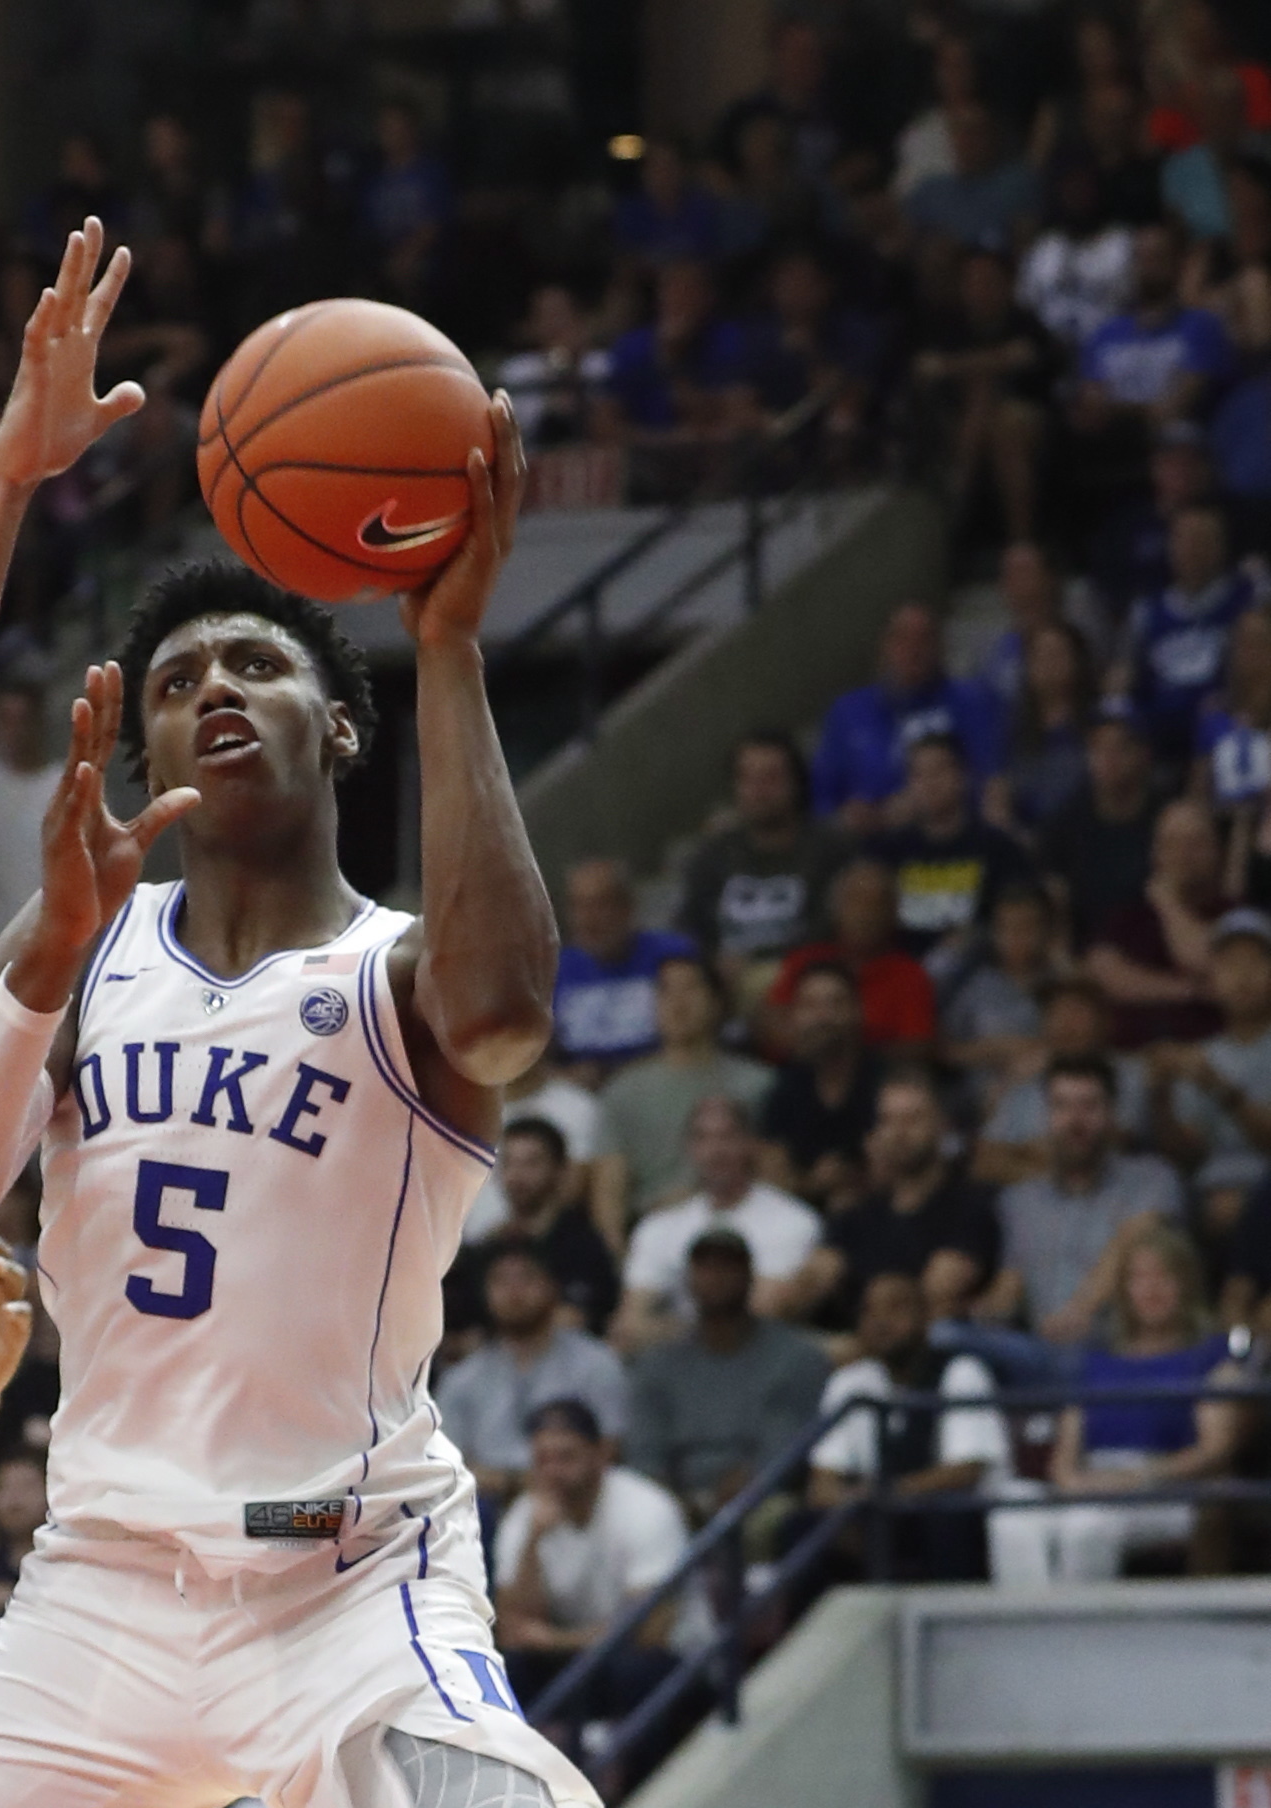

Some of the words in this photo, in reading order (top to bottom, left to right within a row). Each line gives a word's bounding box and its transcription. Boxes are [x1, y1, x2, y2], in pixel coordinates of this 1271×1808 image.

[307, 1002, 343, 1018] ACC
[73, 1042, 352, 1158] DUKE
[125, 1159, 230, 1320] 5
[292, 1501, 343, 1515] NIKE
